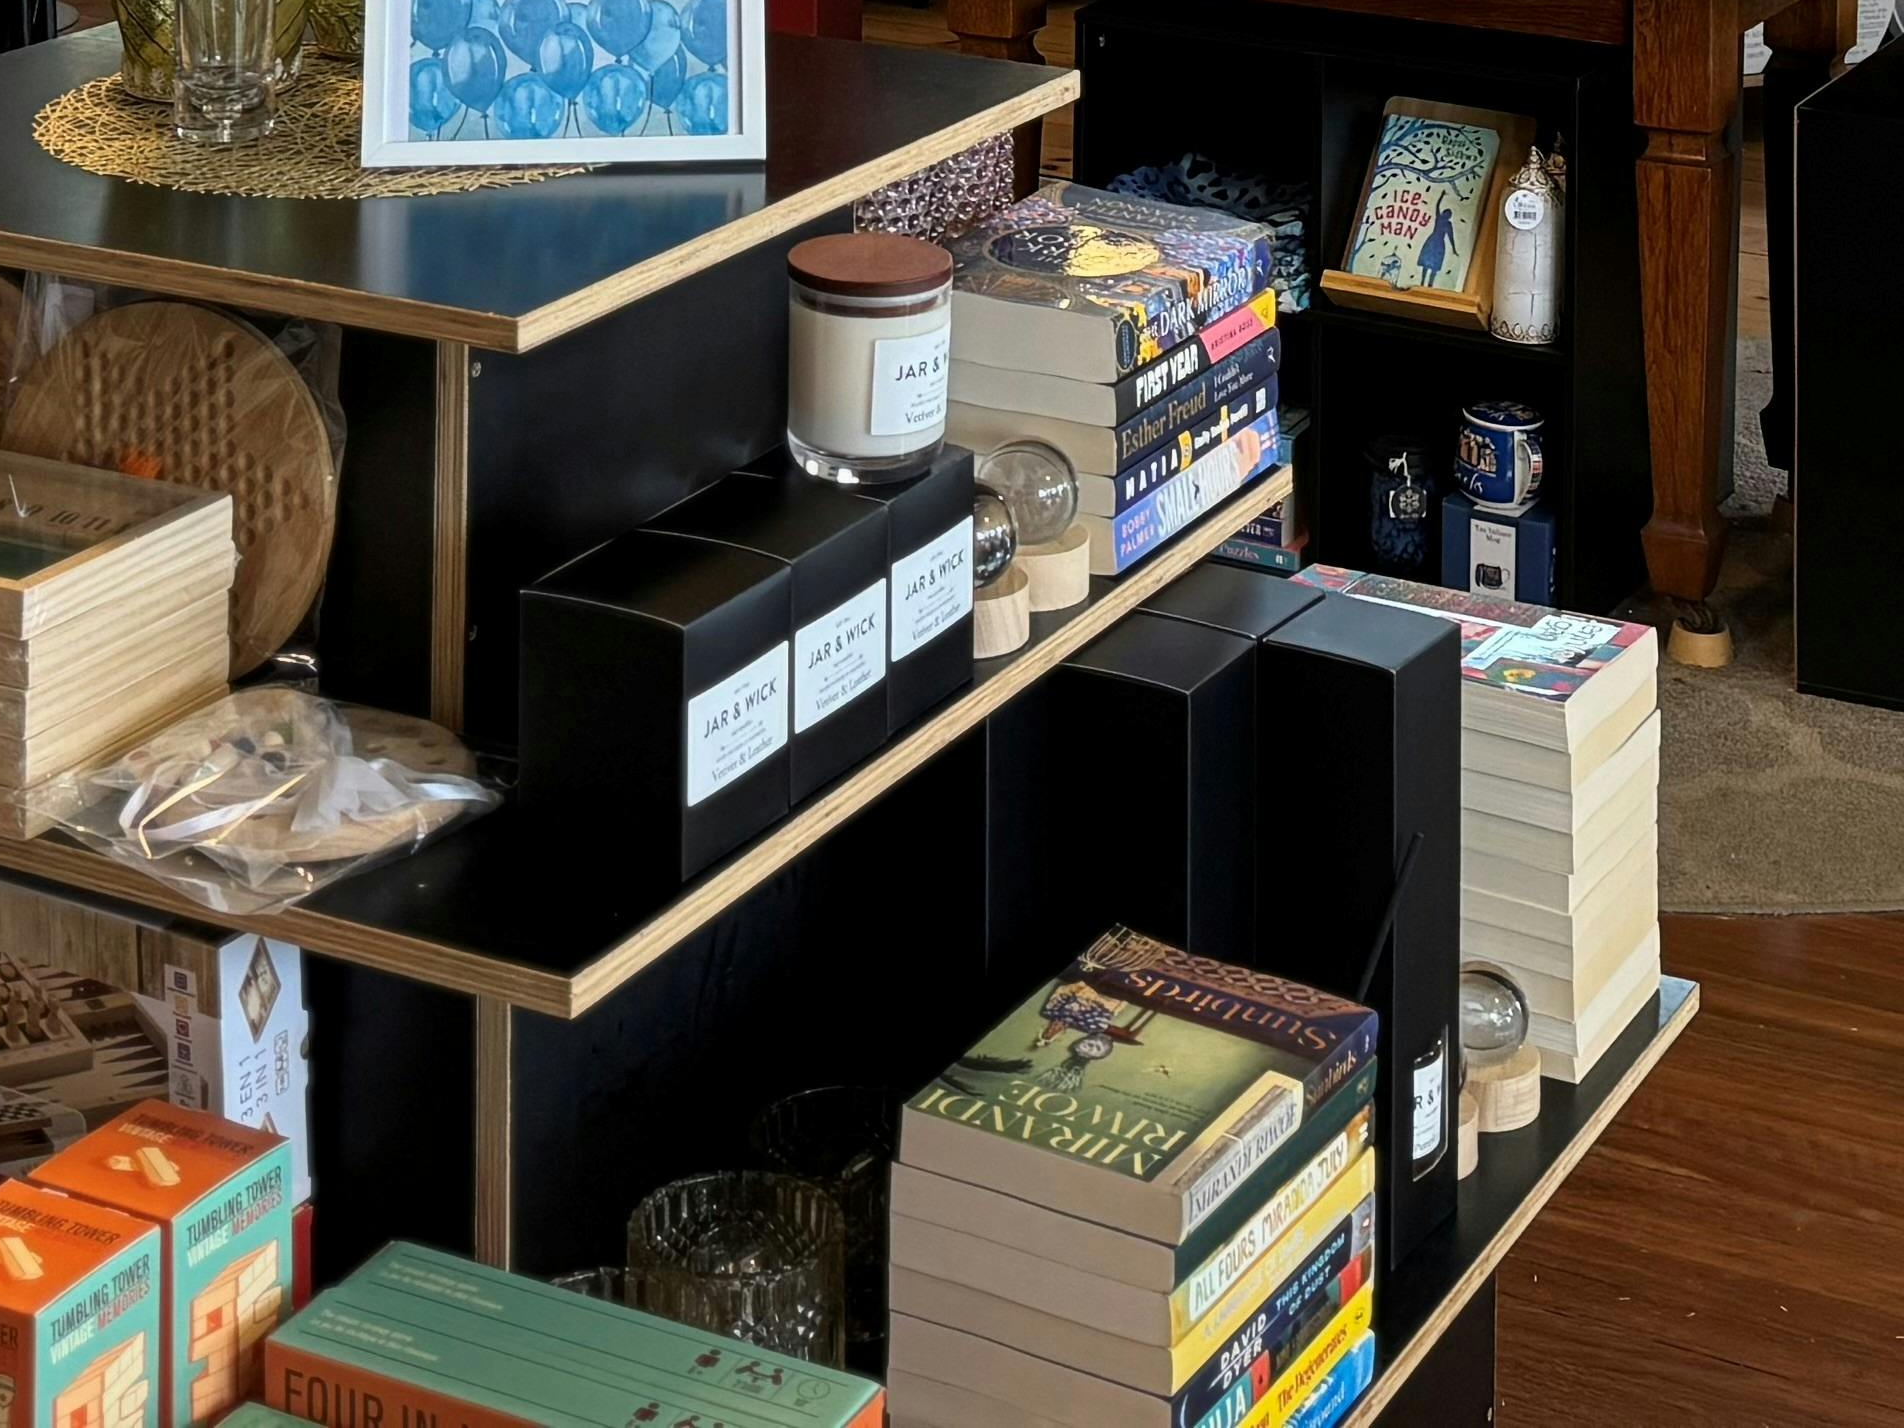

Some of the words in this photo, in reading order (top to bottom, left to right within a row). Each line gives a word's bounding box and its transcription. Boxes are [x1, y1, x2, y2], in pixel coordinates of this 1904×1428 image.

[1160, 300, 1194, 338] DARK
[1197, 266, 1250, 321] MIRROR
[1136, 359, 1169, 407] FIRST
[1169, 345, 1198, 386] YEAR
[1121, 412, 1165, 460] Esther
[1168, 382, 1207, 427] Freud
[1124, 970, 1339, 1053] Sunbirds
[916, 1088, 1164, 1179] MIRANDI
[999, 1079, 1187, 1151] RIWOE
[69, 1222, 121, 1245] TOWER
[187, 1231, 231, 1268] VINTAGE
[230, 1188, 283, 1237] MEMORIES
[1194, 1277, 1217, 1312] ALL
[1219, 1230, 1256, 1294] FOURS
[1261, 1175, 1315, 1244] MIRANDA
[1316, 1137, 1348, 1188] JULY
[1276, 1283, 1301, 1312] THIS
[1300, 1232, 1346, 1286] KINGDOM
[1220, 1312, 1268, 1372] DAVID
[1223, 1339, 1264, 1388] DYER
